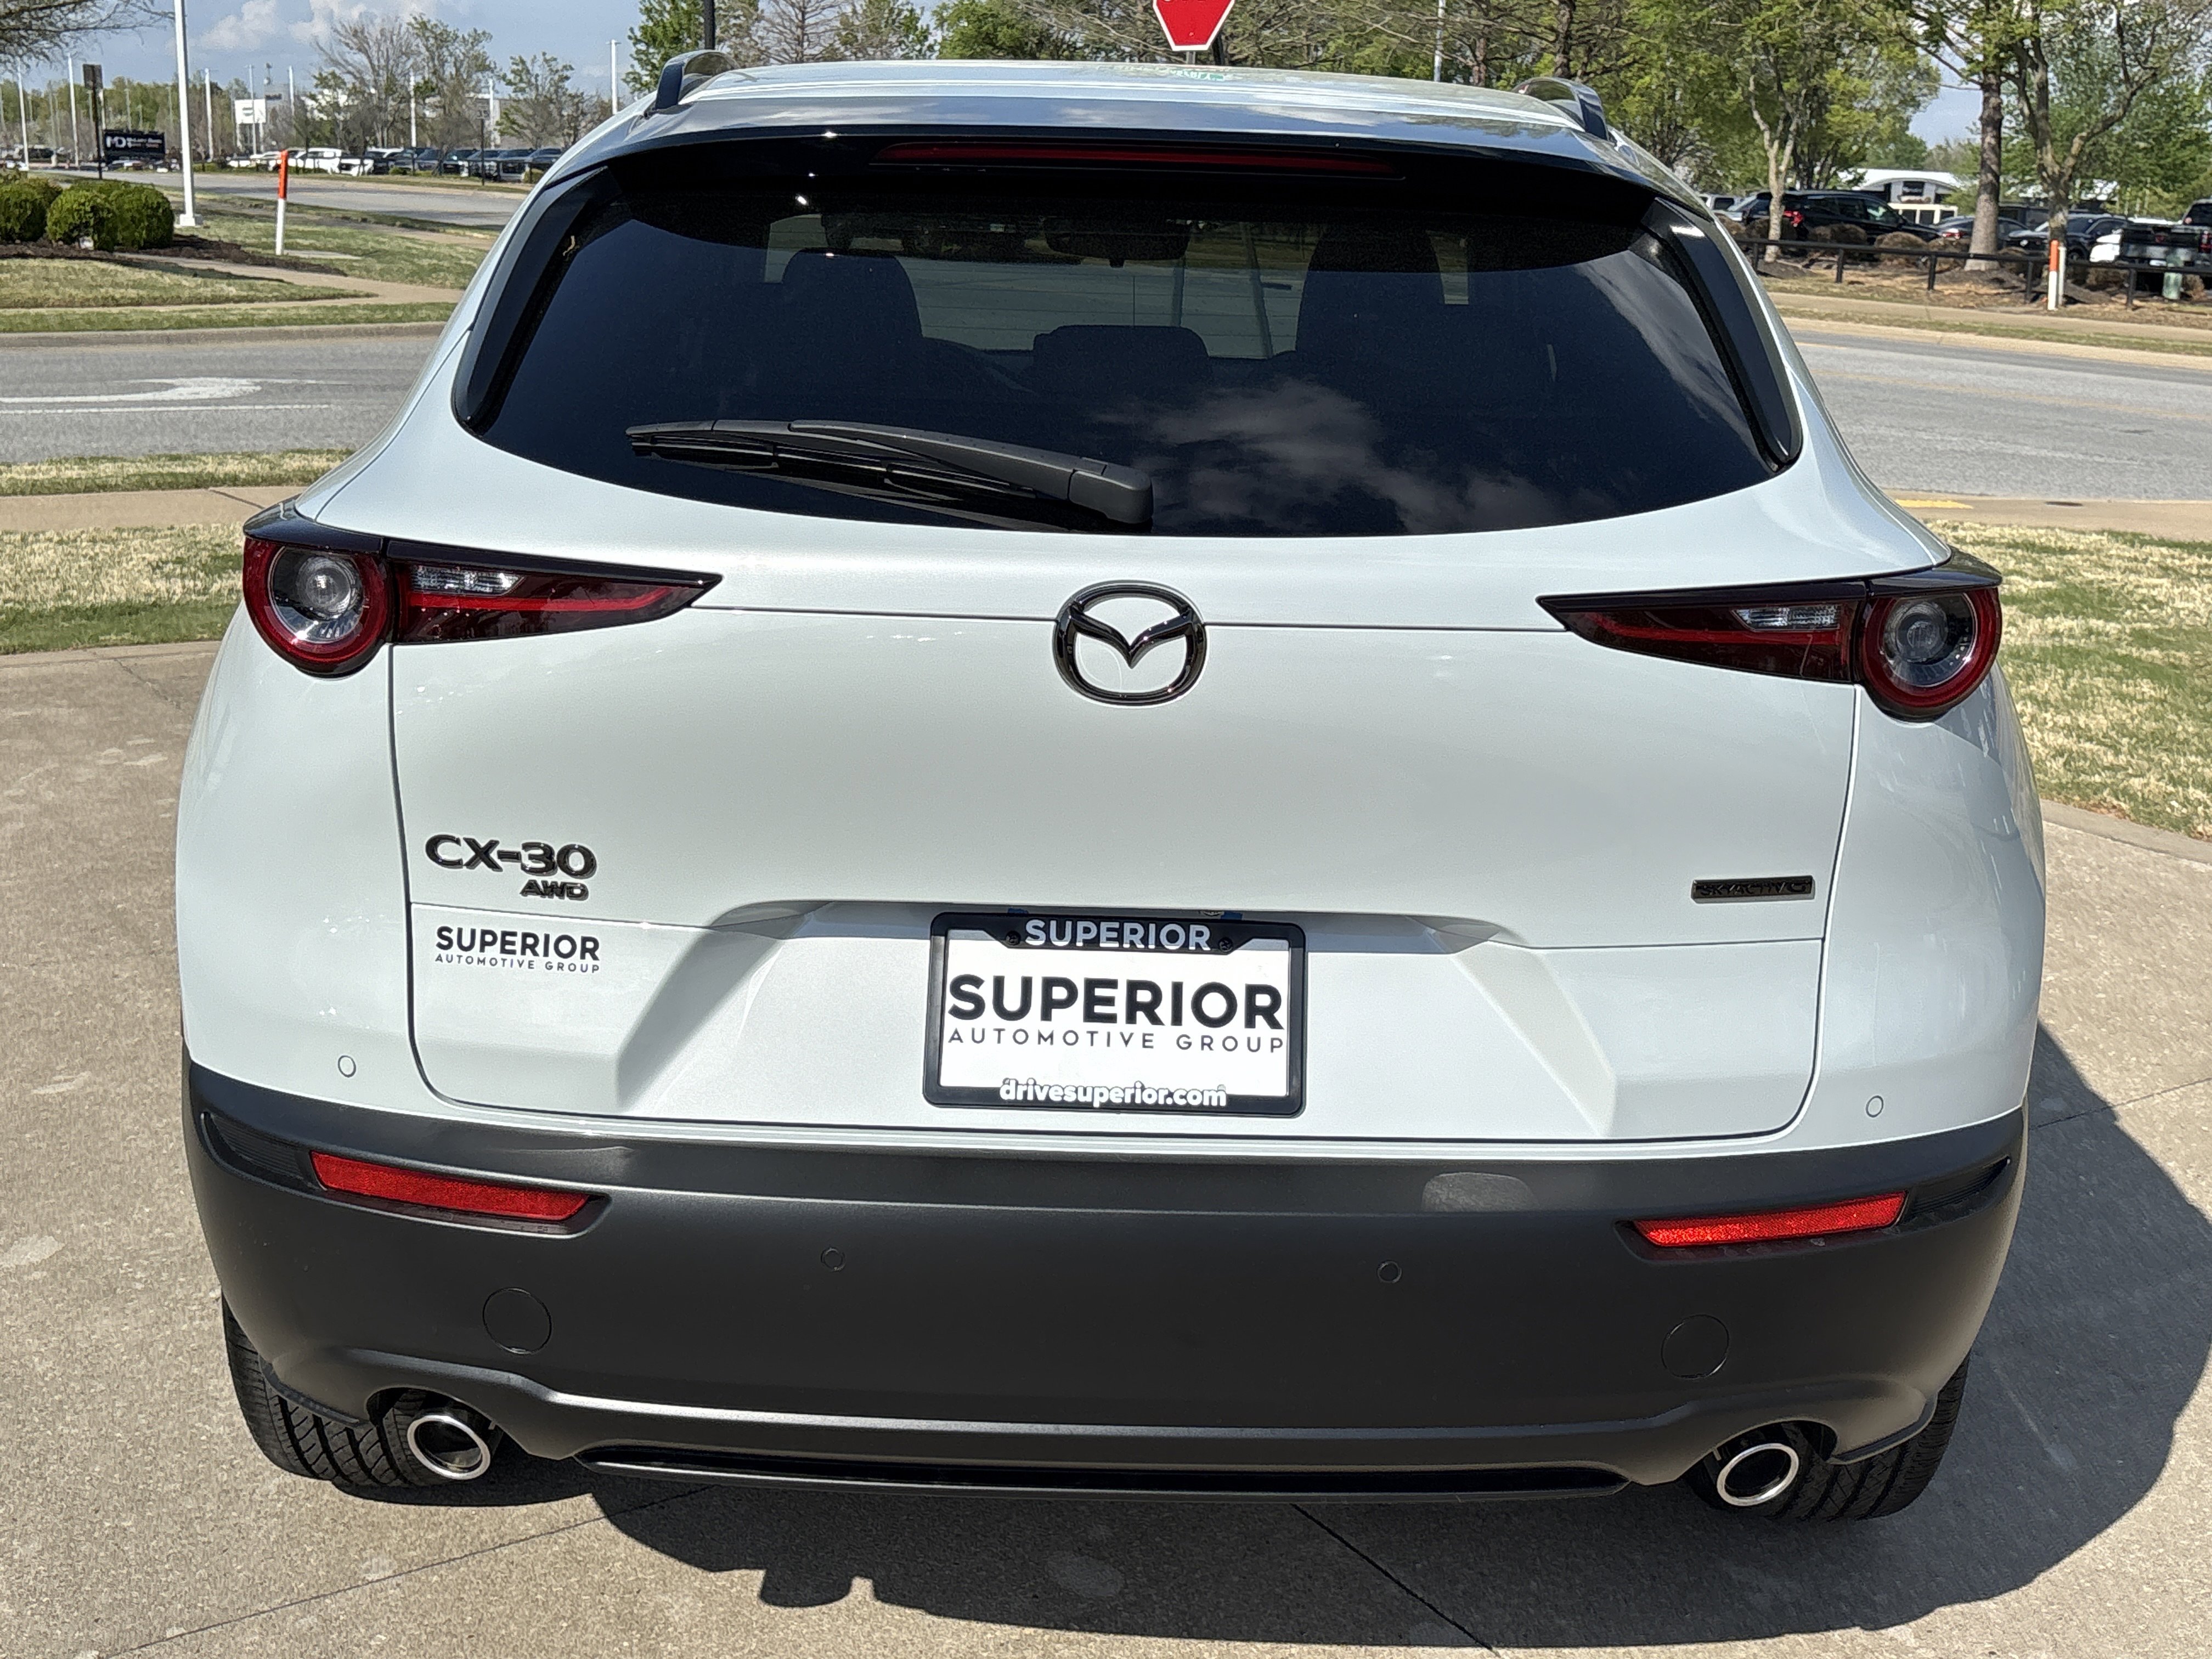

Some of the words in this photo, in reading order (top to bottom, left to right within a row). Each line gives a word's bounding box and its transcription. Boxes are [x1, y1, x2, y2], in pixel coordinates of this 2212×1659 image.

[425, 834, 597, 879] CX-30
[520, 879, 589, 901] AWD
[436, 926, 600, 961] SUPERIOR
[1025, 919, 1211, 951] SUPERIOR
[436, 953, 535, 969] AUTOMOTIVE
[545, 961, 600, 973] GROUP
[949, 974, 1284, 1029] SUPERIOR
[949, 1028, 1154, 1048] AUTOMOTIVE
[1176, 1035, 1283, 1053] GROUP
[1000, 1079, 1227, 1108] drivesuperior.com
